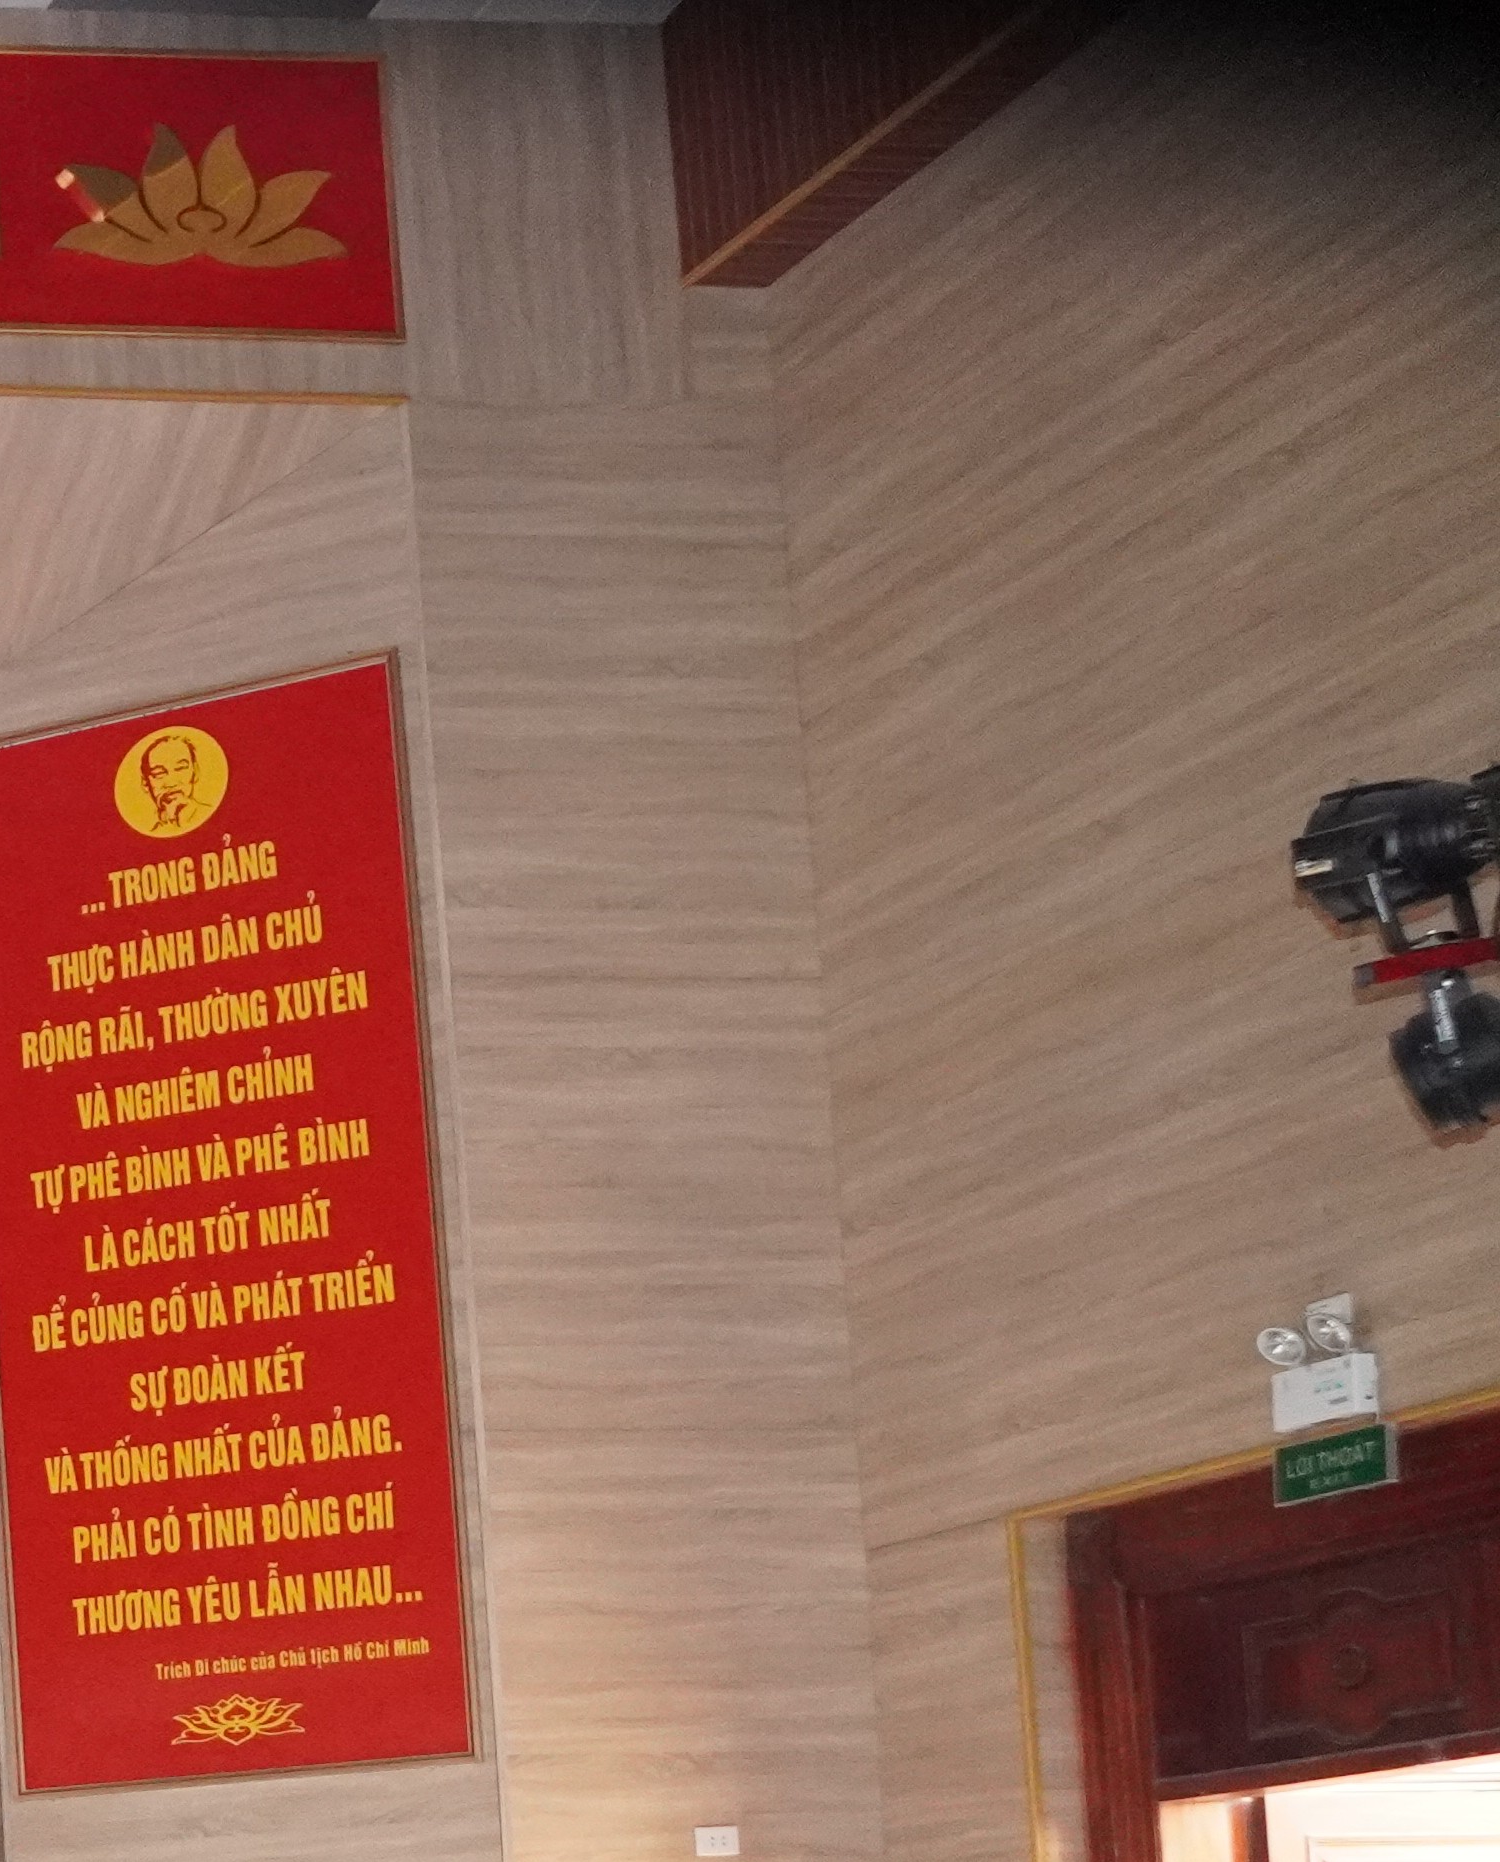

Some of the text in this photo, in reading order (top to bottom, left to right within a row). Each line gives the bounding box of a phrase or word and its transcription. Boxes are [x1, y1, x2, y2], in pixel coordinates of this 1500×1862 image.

[202, 834, 277, 890] ĐẢNG
[47, 890, 322, 993] THỰC HÀNH DÂN CHỦ
[22, 967, 368, 1072] RỘNG RÃI, THƯỜNG XUYÊN
[76, 1046, 314, 1129] VÀ NGHIÊM CHỈNH
[30, 1117, 369, 1213] TỰ PHÊ BÌNH VÀ PHÊ BÌNH
[84, 1188, 330, 1272] LÀ CÁCH TỐT NHẤT
[32, 1250, 395, 1352] ĐỂ CỦNG CỐ VÀ PHÁT TRIỂN
[130, 1342, 304, 1416] SỰ ĐOÀN KẾT
[45, 1406, 402, 1494] VÀ THỐNG NHẤT CỦA ĐẢNG.
[73, 1482, 394, 1563] PHẢI CÓ TÌNH ĐỒNG CHÍ
[72, 1588, 181, 1636] THƯƠNG
[186, 1576, 241, 1624] YÊU
[249, 1563, 306, 1617] LẪN
[155, 1661, 191, 1680] Trích
[195, 1659, 209, 1676] Di
[212, 1655, 247, 1674] chúc
[250, 1651, 276, 1672] của
[279, 1647, 306, 1667] Chủ
[366, 1640, 390, 1659] Chí
[394, 1637, 429, 1656] Minh
